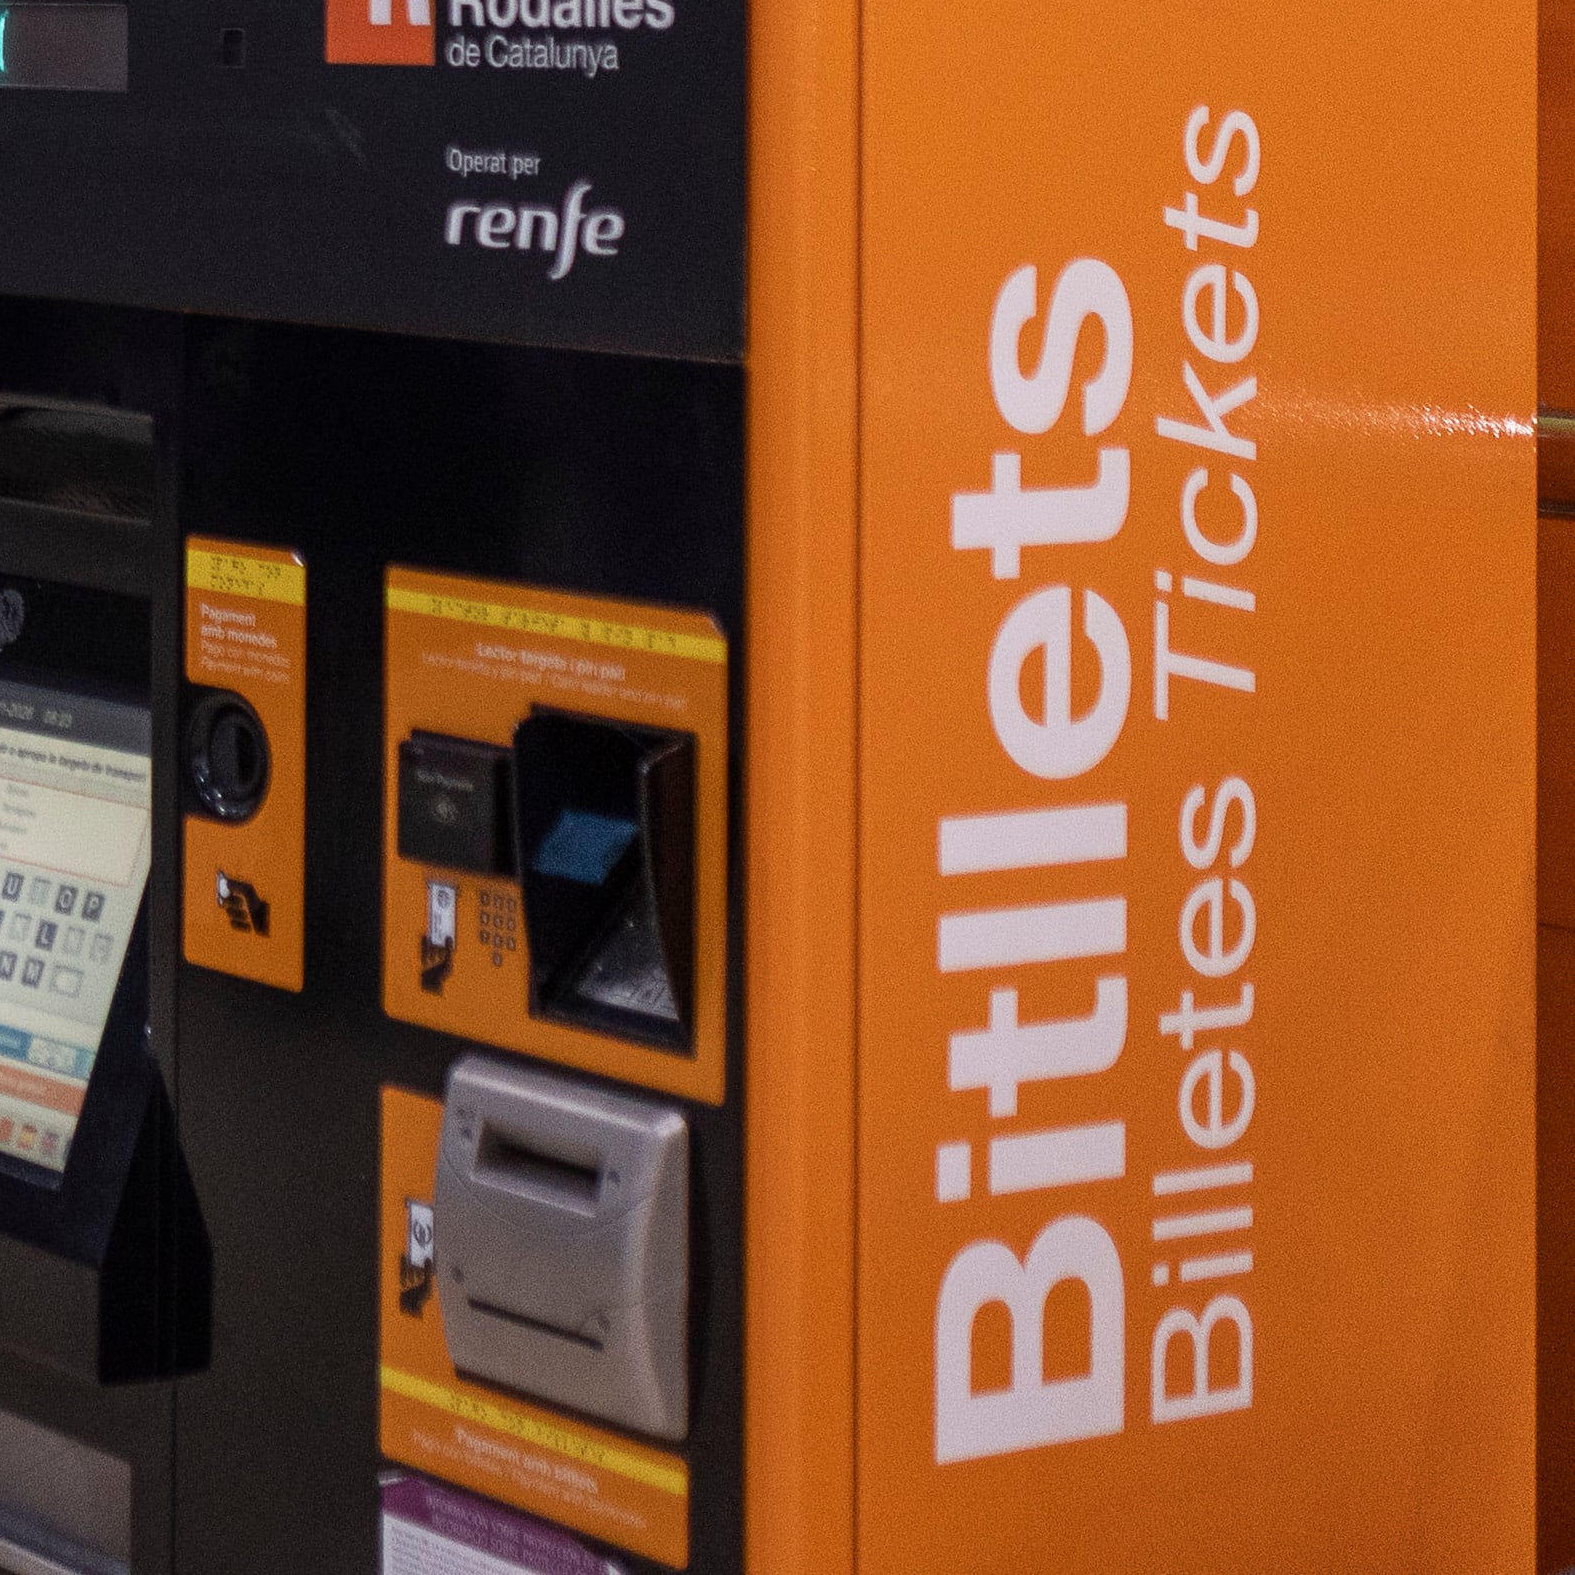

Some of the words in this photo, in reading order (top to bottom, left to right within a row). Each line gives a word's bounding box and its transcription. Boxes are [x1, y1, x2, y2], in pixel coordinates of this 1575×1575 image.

[447, 36, 480, 68] de
[486, 35, 620, 78] Catalunya
[446, 146, 507, 176] Operat
[511, 153, 541, 180] per
[444, 178, 625, 280] renfe
[1154, 104, 1262, 725] Tickets
[200, 603, 256, 626] Pagament
[200, 625, 225, 640] amb
[227, 629, 278, 648] monedes
[934, 256, 1134, 1468] Bitllets
[1151, 774, 1258, 1428] Billetes
